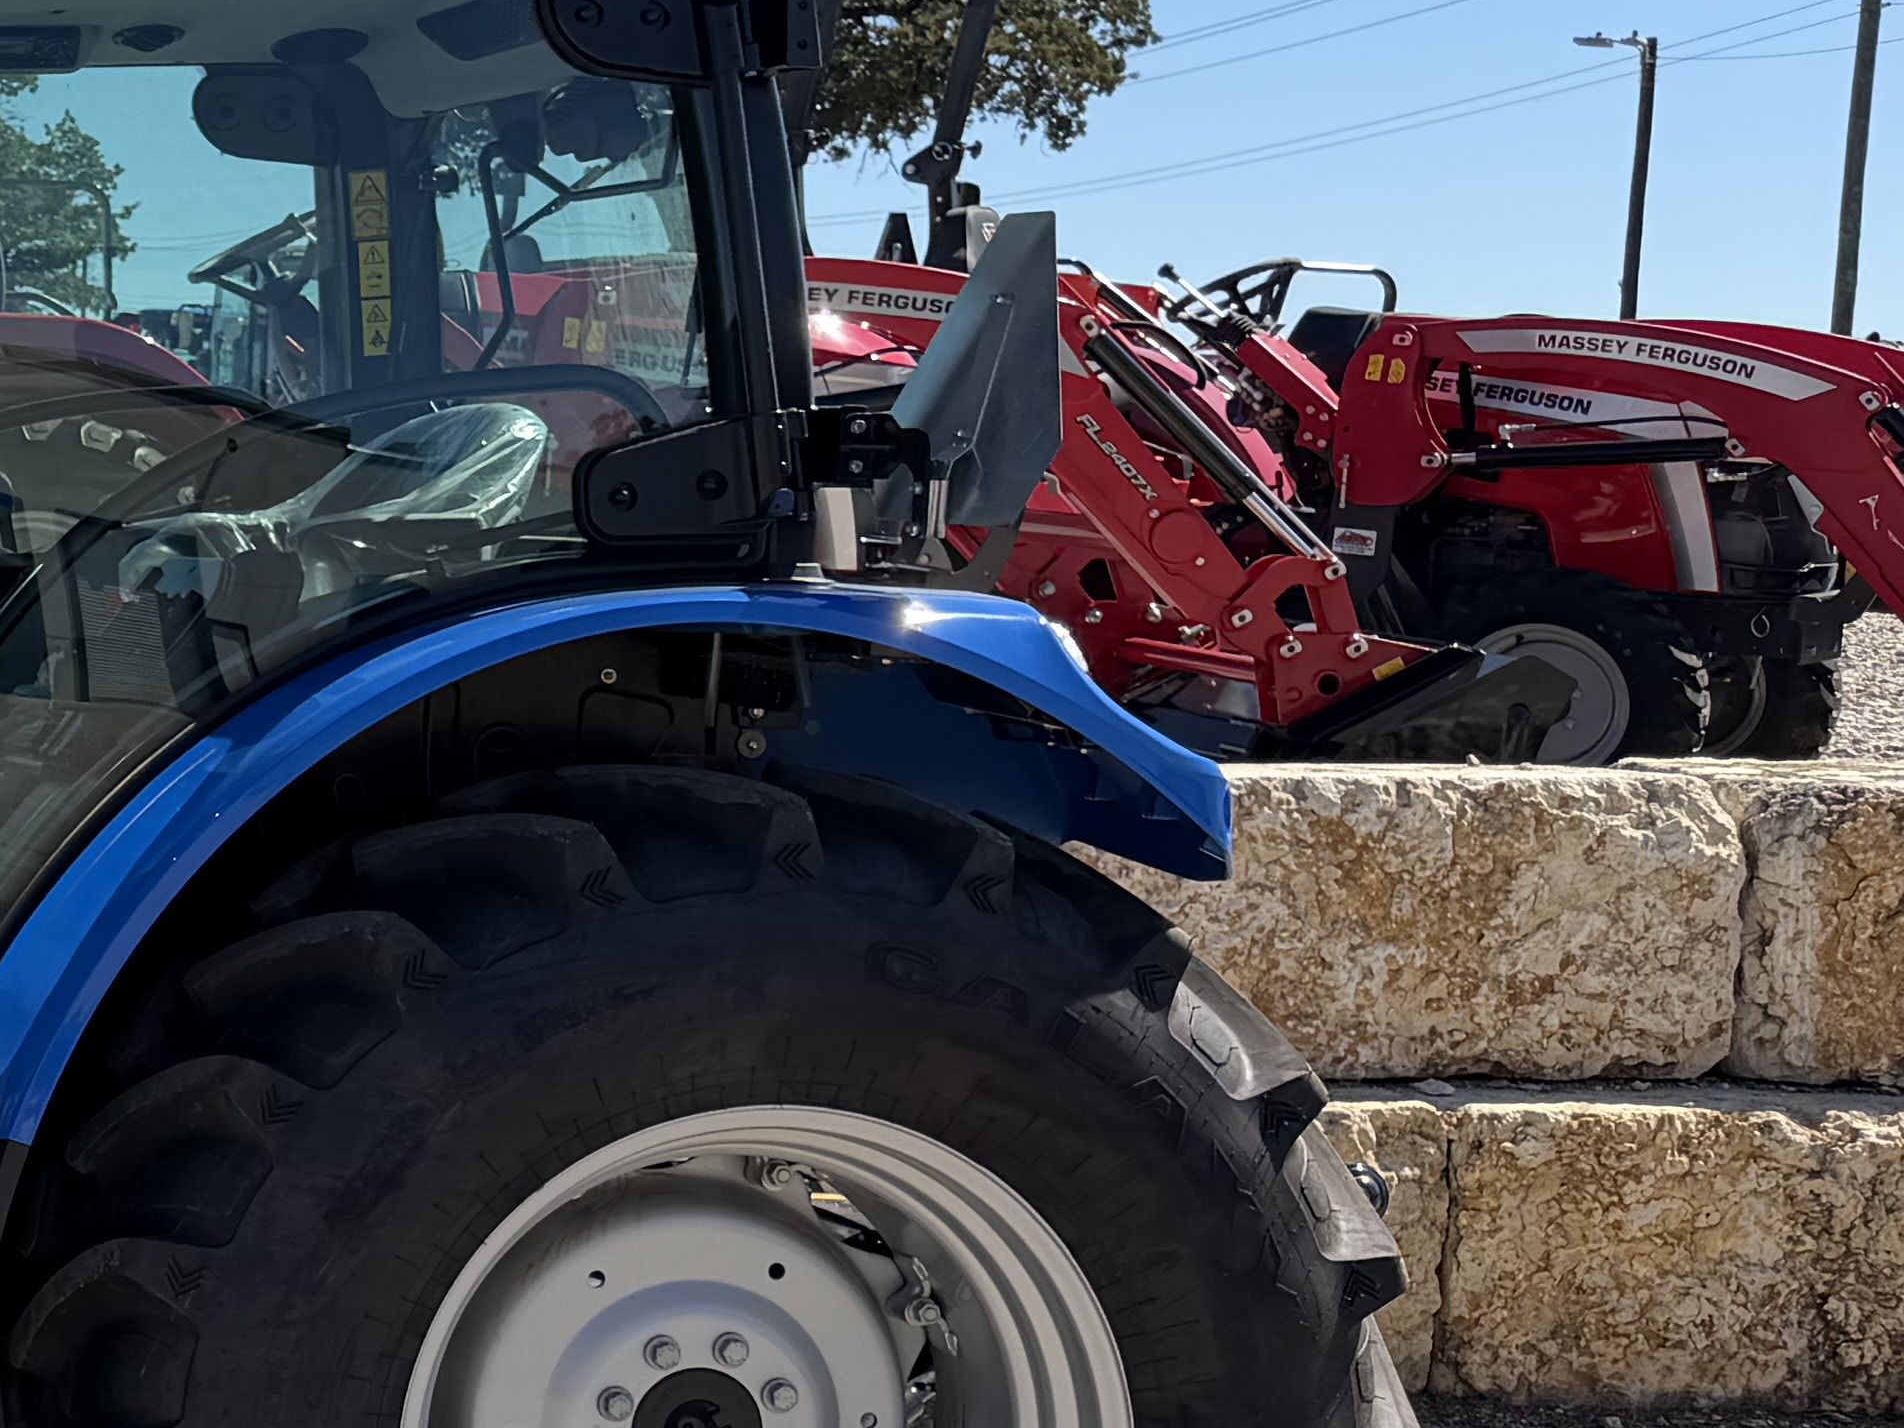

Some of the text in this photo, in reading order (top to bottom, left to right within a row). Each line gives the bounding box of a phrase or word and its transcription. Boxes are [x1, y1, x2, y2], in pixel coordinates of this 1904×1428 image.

[1537, 333, 1756, 380] MASSEY FERGUSON
[1473, 382, 1592, 416] FERGUSON
